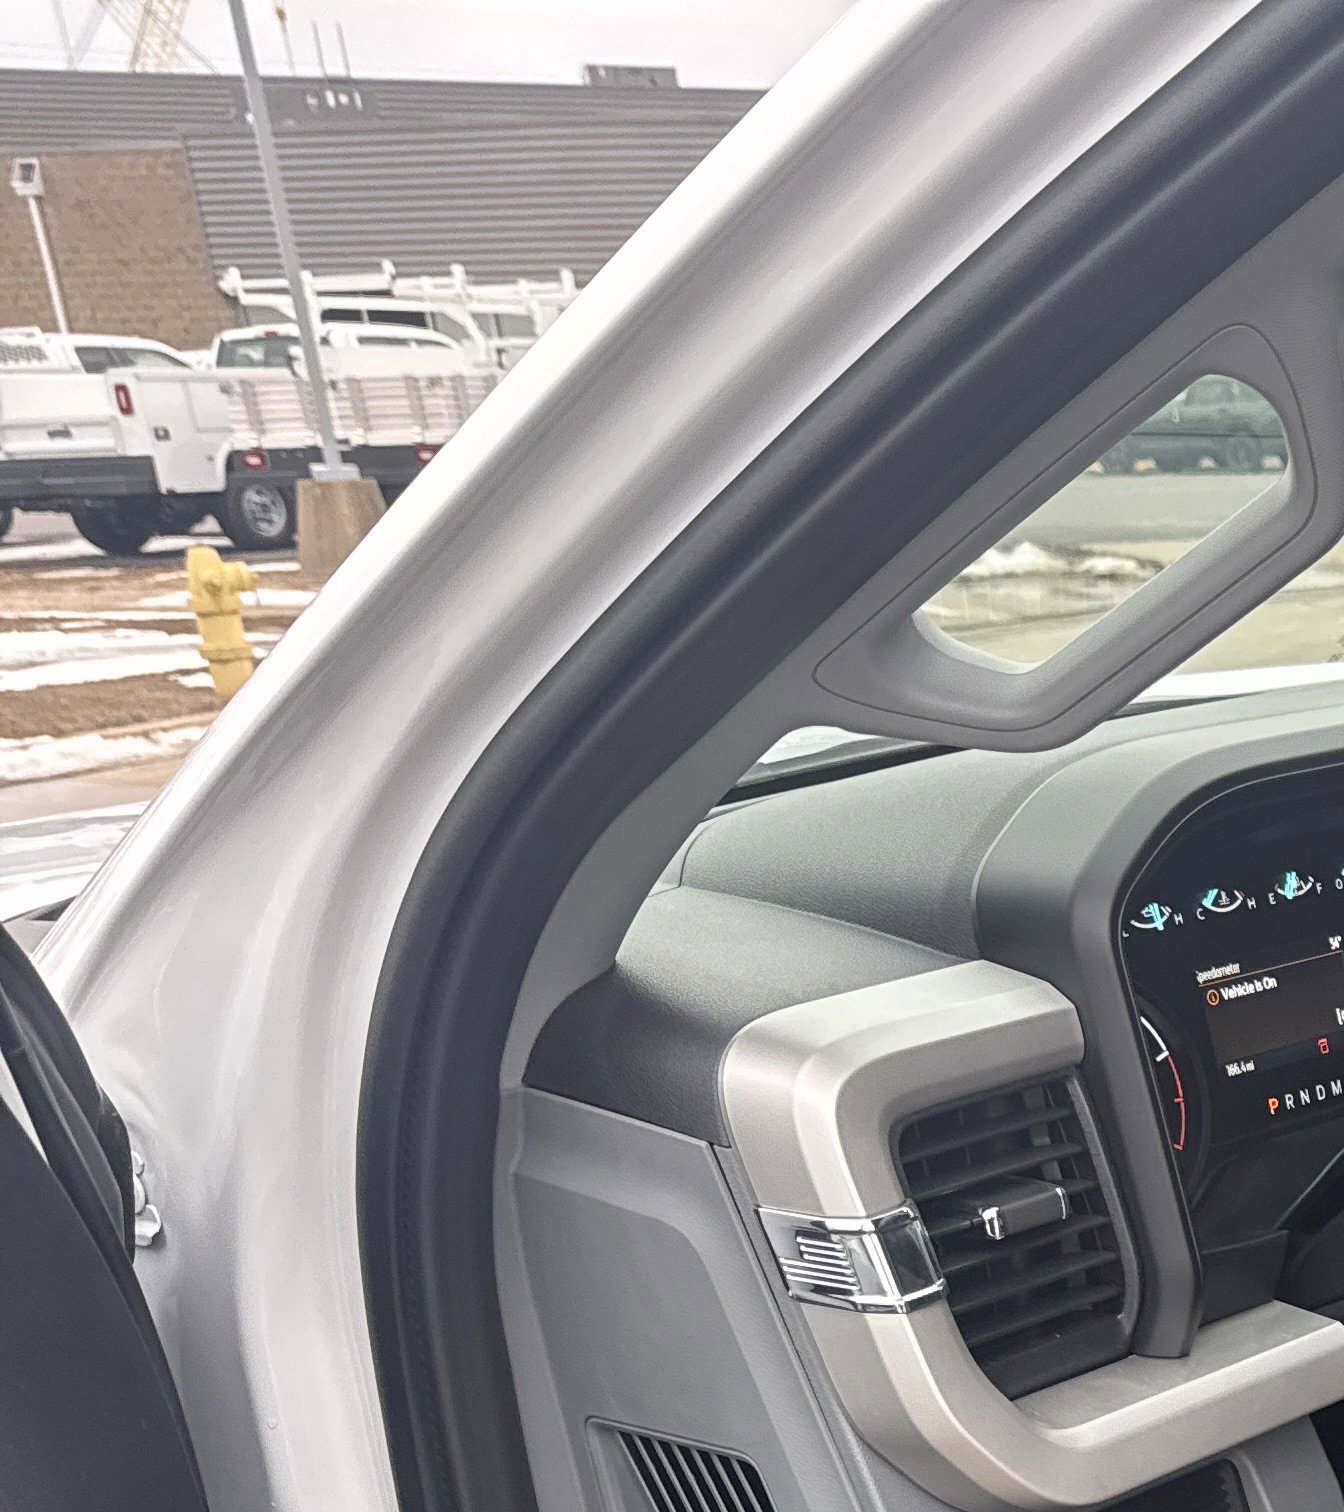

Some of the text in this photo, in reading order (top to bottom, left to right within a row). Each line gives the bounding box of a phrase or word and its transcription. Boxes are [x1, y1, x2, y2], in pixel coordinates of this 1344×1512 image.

[1247, 897, 1257, 910] H
[1173, 912, 1184, 925] H
[1220, 981, 1255, 1001] Vehicle
[1262, 976, 1278, 990] On
[1267, 1079, 1343, 1116] P R N D M
